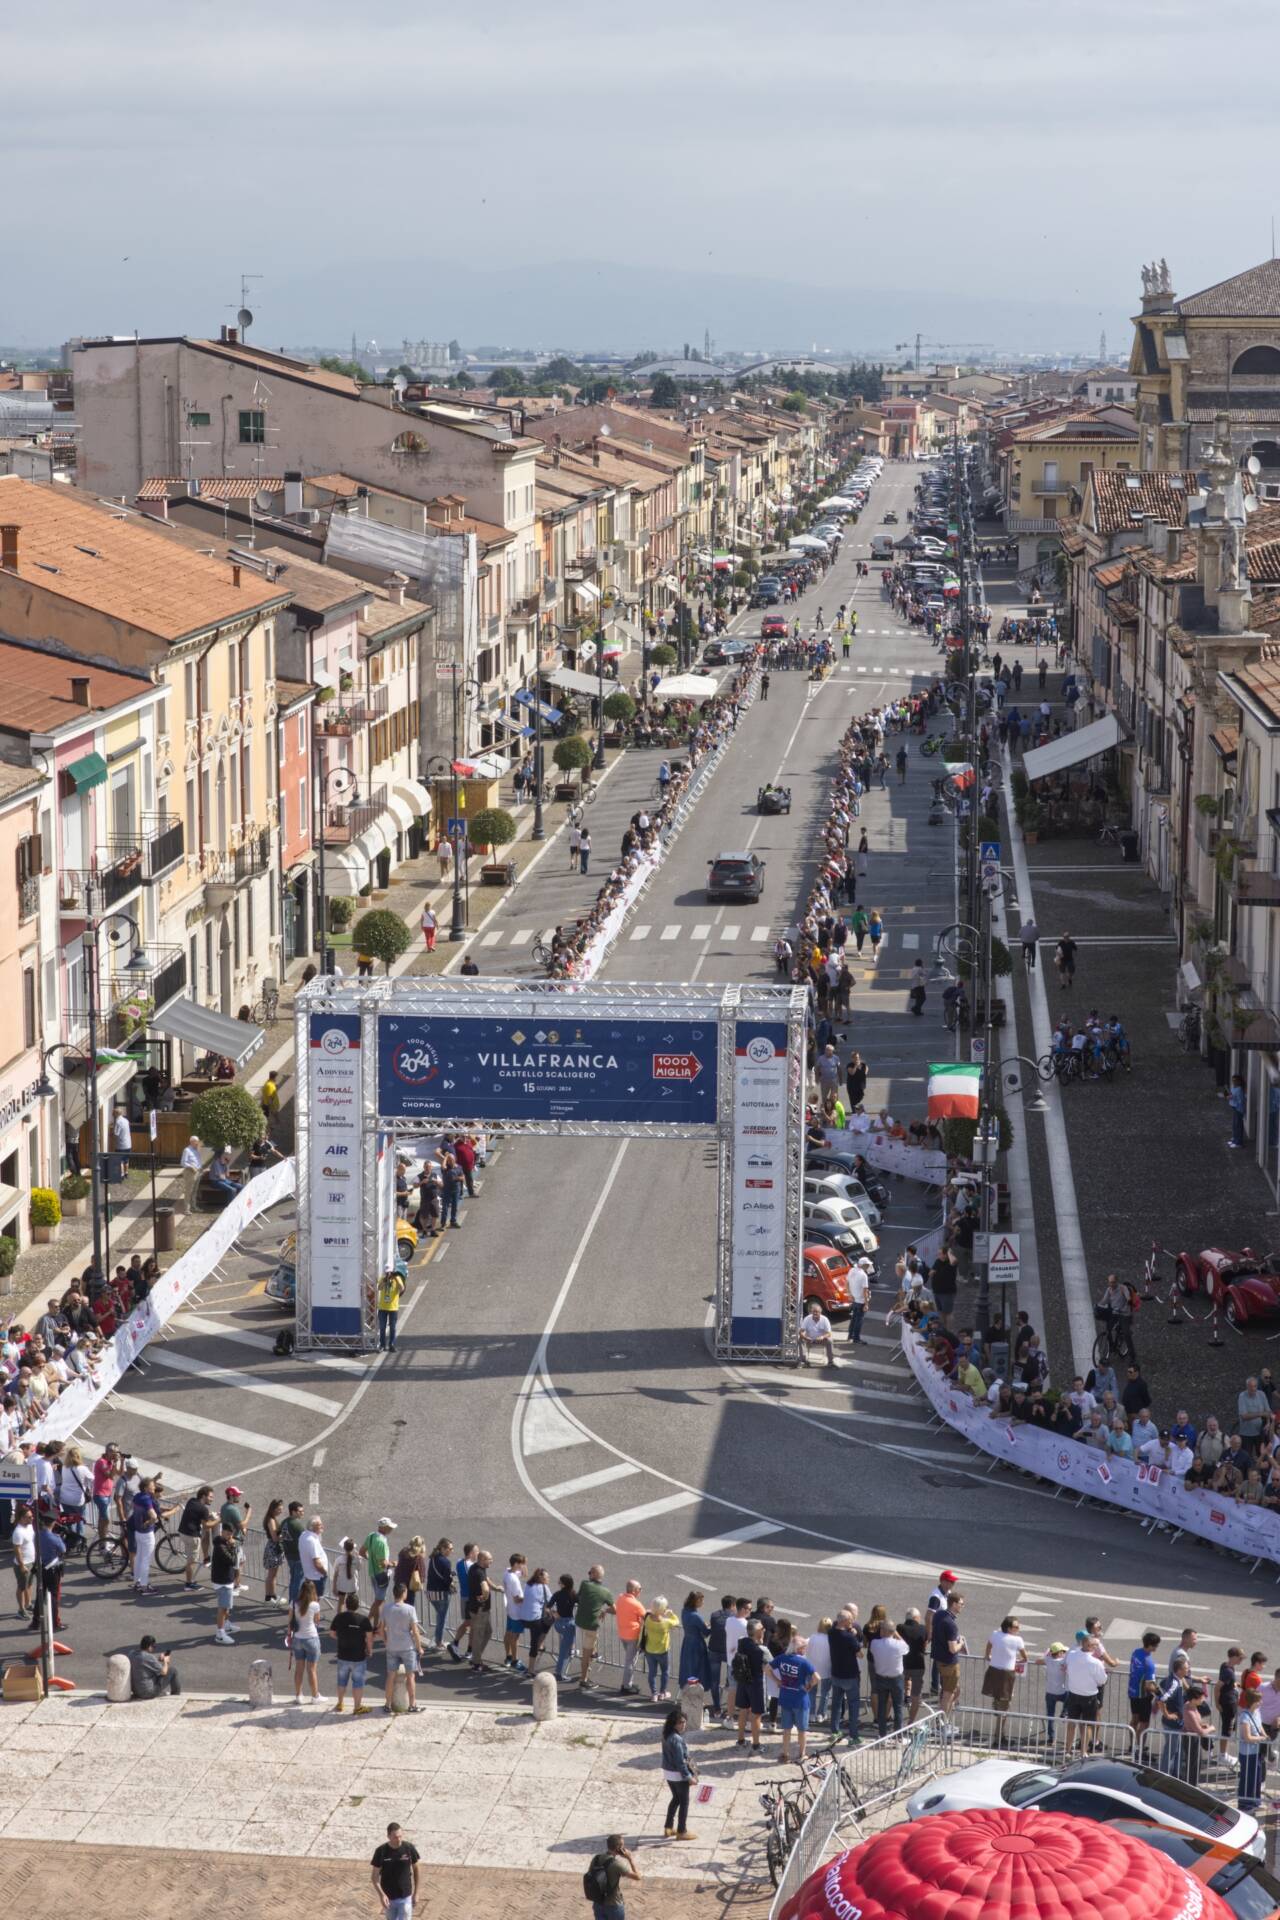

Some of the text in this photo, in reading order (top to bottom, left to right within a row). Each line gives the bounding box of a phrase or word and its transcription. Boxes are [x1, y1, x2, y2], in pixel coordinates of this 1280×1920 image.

[400, 1049, 430, 1073] 2024
[477, 1053, 619, 1069] VILLAFRANCA
[658, 1057, 689, 1066] 1000
[499, 1070, 596, 1079] CASTELLO SCALIGERO
[656, 1068, 691, 1077] MIGLIA
[523, 1082, 536, 1093] 15
[781, 1662, 799, 1675] KTS
